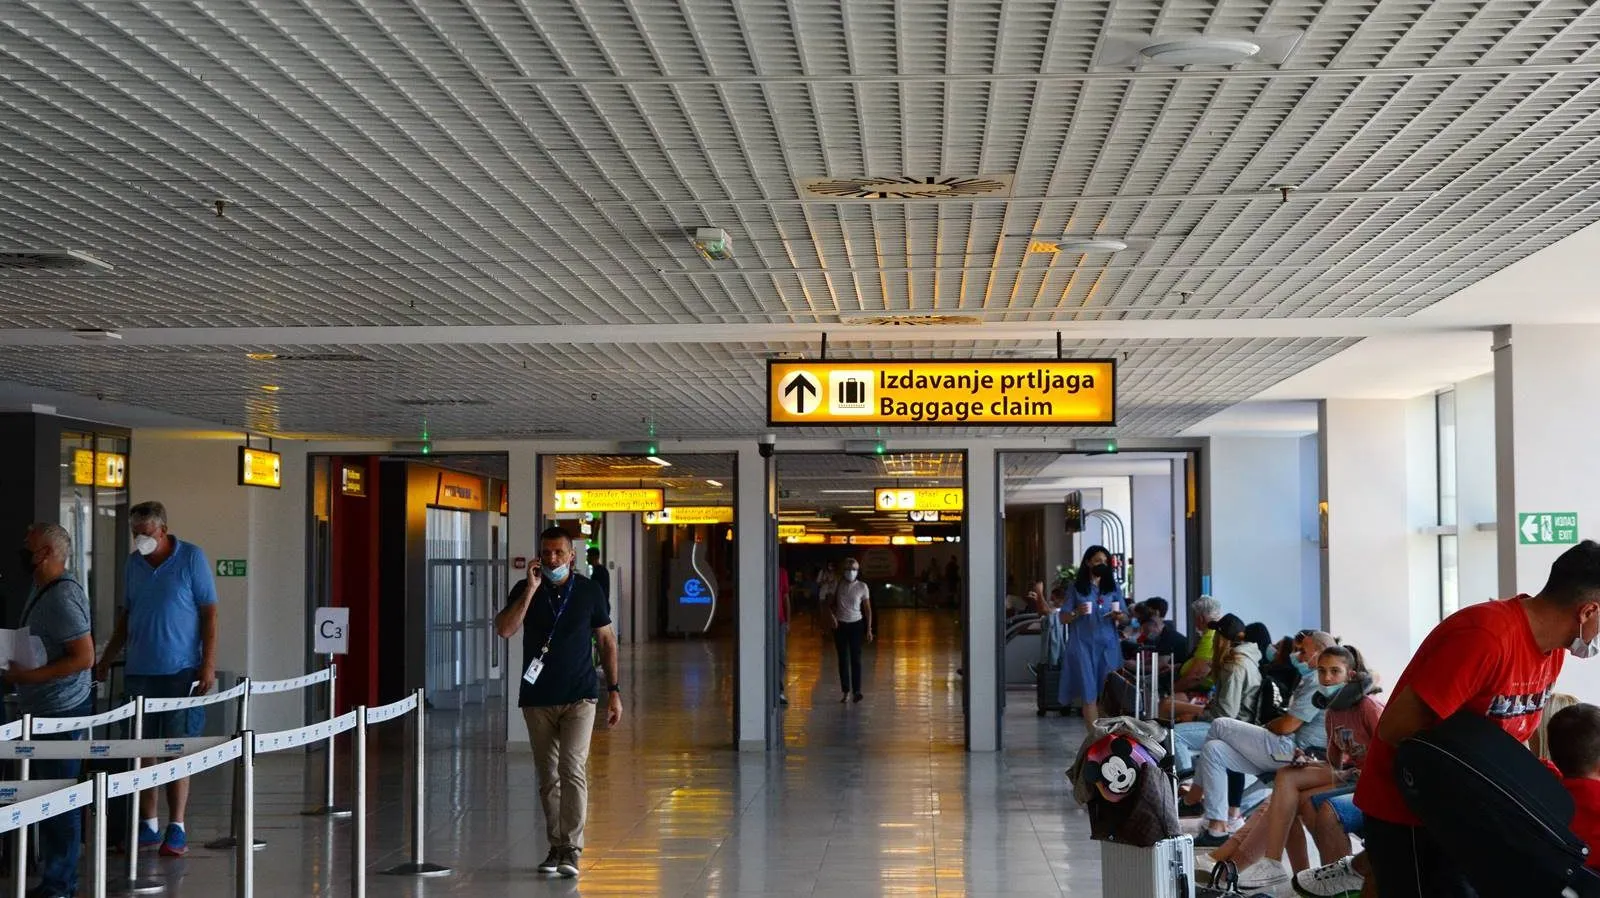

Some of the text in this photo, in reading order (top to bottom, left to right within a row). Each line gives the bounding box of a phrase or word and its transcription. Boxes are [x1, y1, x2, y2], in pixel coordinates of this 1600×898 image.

[880, 369, 1095, 393] Izdavanje prtljaga
[880, 396, 1053, 420] Baggage claim
[620, 490, 647, 498] Transit
[943, 493, 958, 504] C1
[586, 500, 657, 509] Connecting flights
[1559, 530, 1573, 540] EXIT
[320, 619, 342, 639] C3
